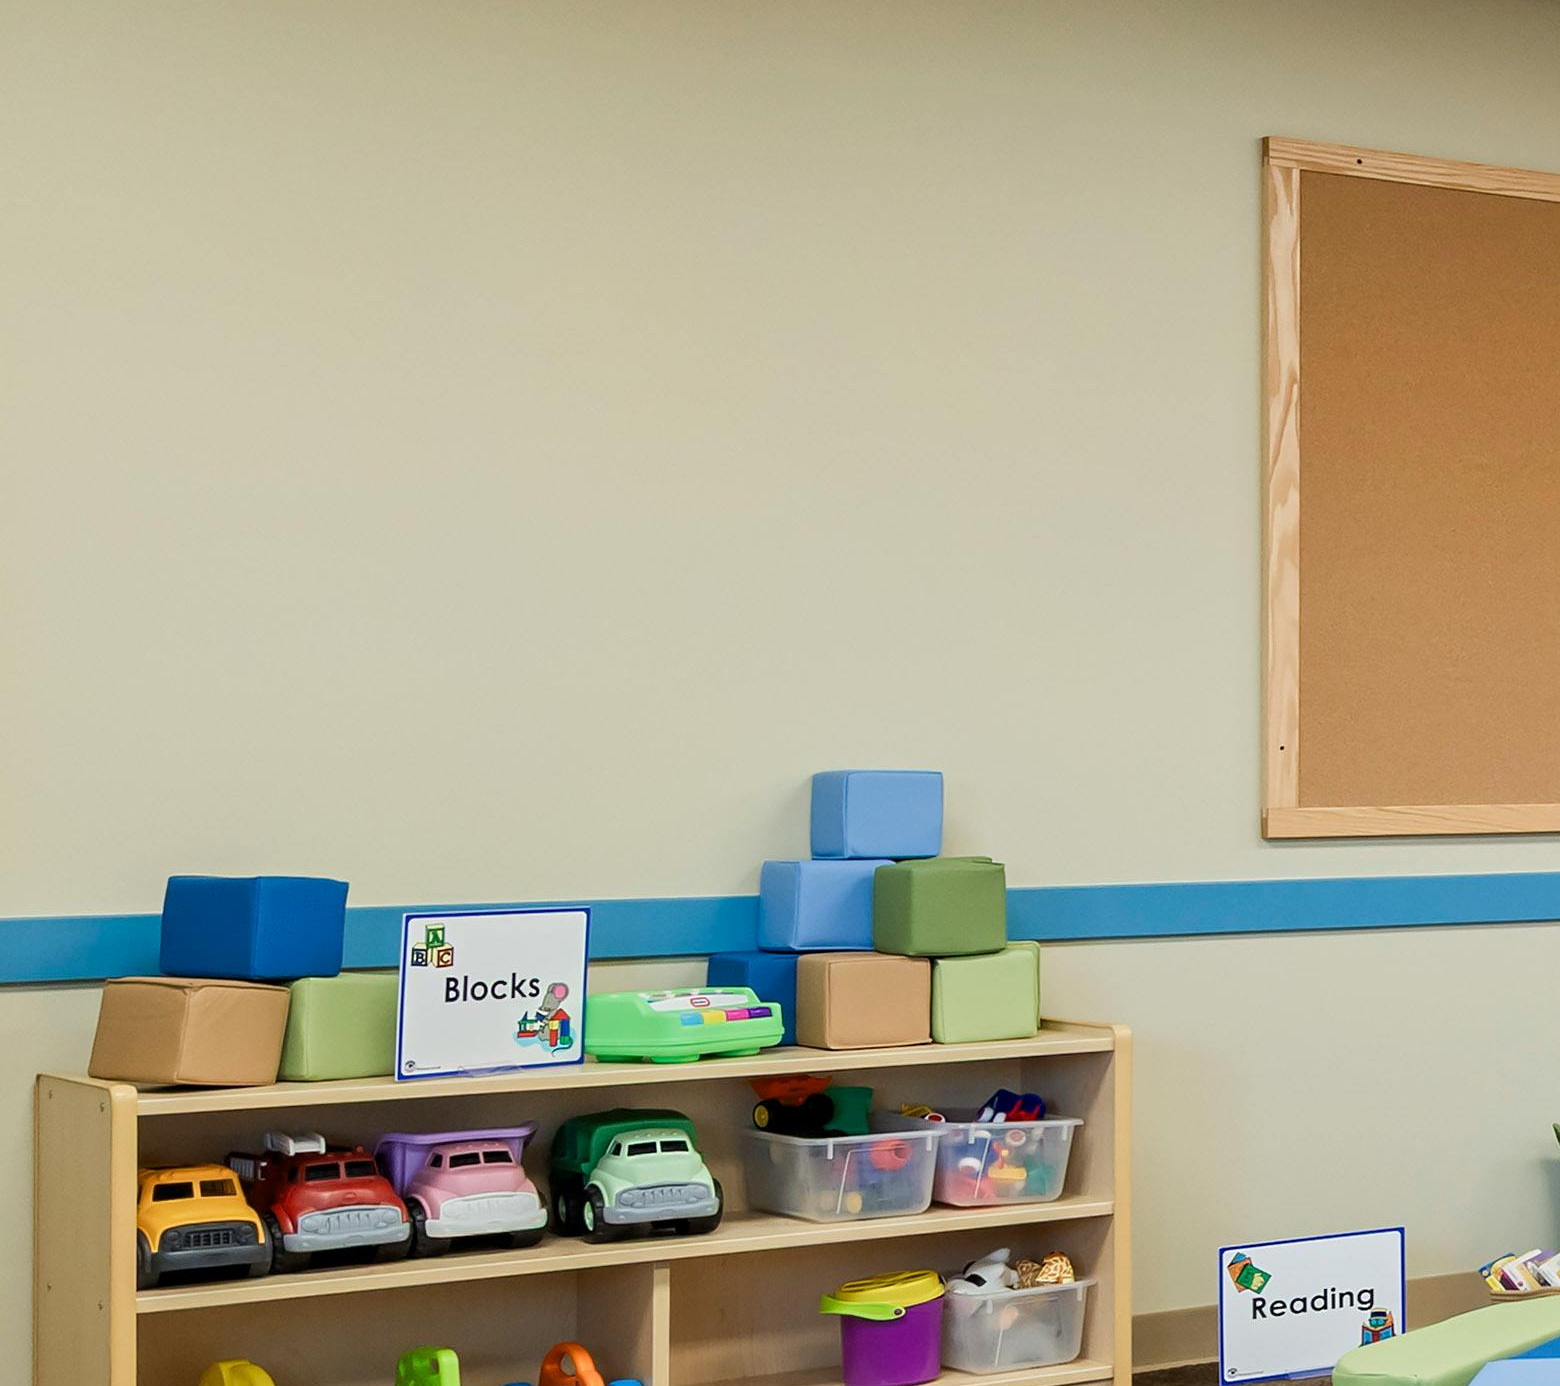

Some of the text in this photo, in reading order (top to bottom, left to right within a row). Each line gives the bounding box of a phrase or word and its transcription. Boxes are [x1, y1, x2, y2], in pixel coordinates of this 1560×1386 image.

[430, 931, 441, 944] A
[415, 951, 426, 964] B
[439, 951, 451, 964] C
[444, 972, 541, 1003] Blocks
[1251, 1287, 1375, 1320] Reading
